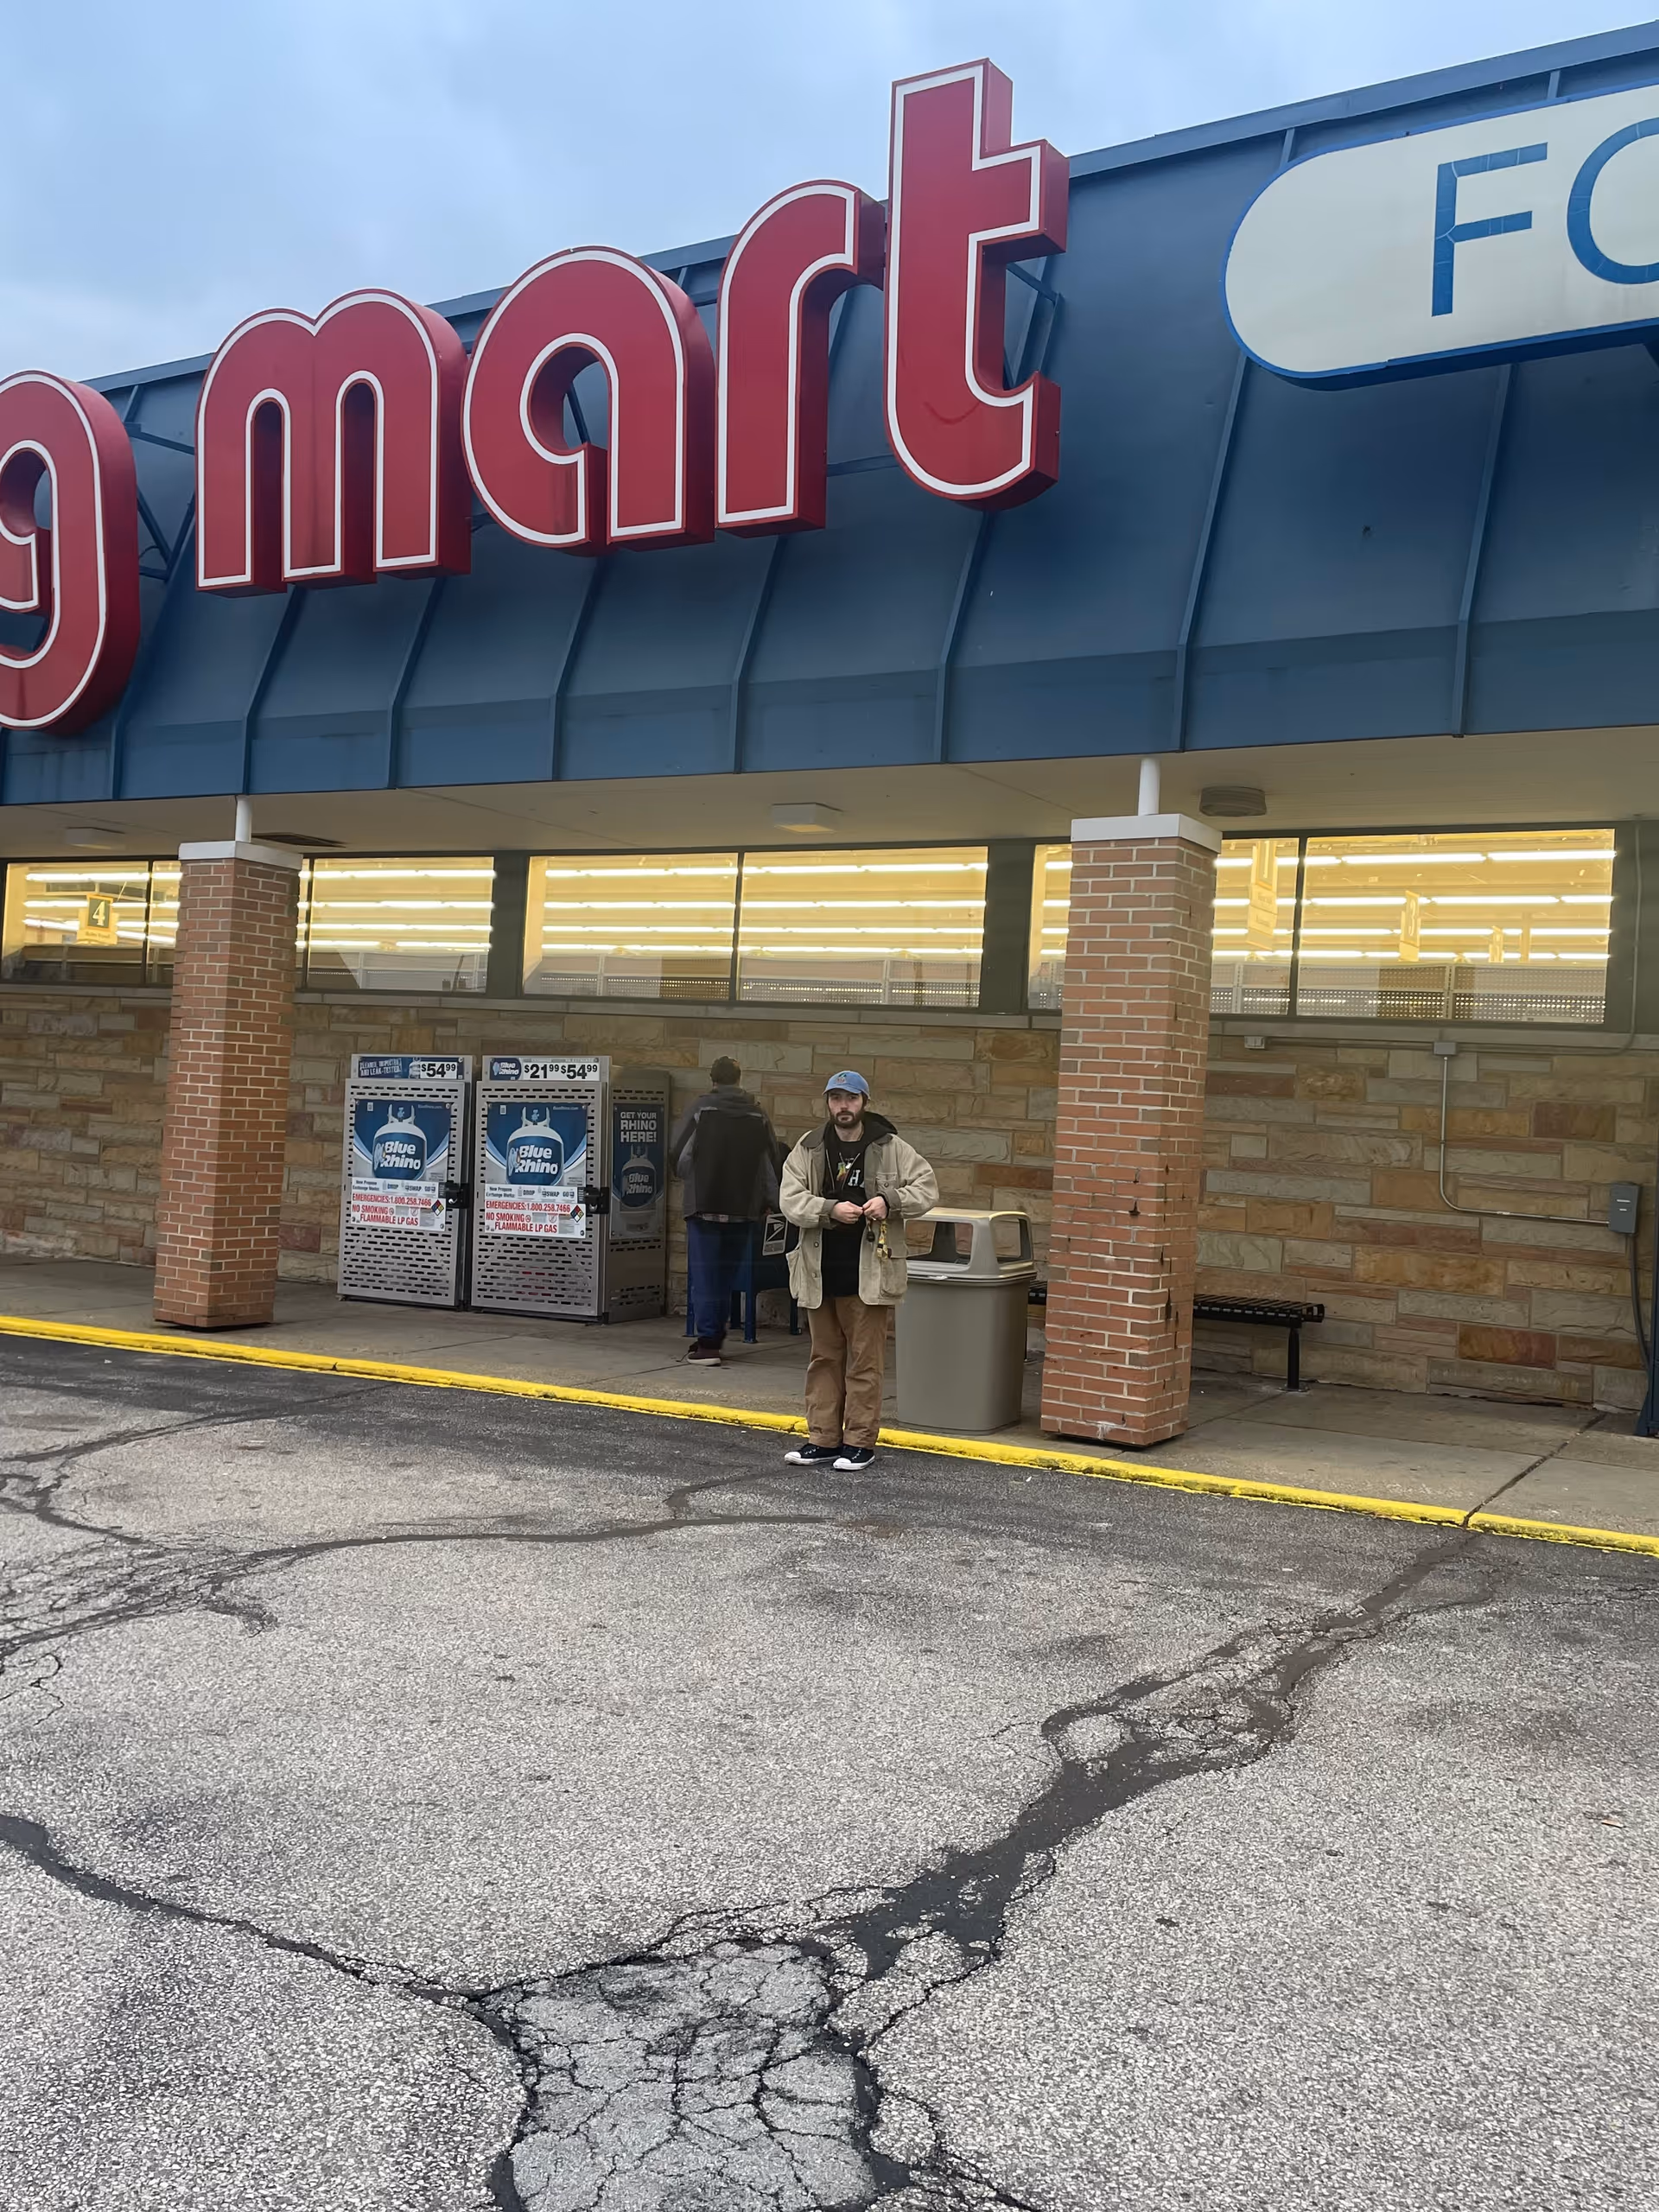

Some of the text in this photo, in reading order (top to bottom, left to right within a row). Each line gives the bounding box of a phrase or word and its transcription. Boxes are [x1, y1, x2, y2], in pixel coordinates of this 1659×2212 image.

[195, 58, 1068, 594] mart
[92, 900, 105, 926] 4
[620, 1120, 657, 1130] RHINO
[620, 1131, 657, 1142] HERE!
[385, 1141, 416, 1154] Blue
[519, 1145, 552, 1159] Blue
[380, 1154, 421, 1170] Rhino
[515, 1159, 558, 1175] Rhino
[628, 1173, 649, 1183] Blue
[626, 1183, 652, 1194] Rhino
[352, 1204, 360, 1213] NO
[361, 1205, 389, 1215] SMOKING
[359, 1213, 396, 1224] FLAMMABLE
[397, 1216, 404, 1225] LP
[406, 1217, 419, 1226] GAS
[486, 1211, 495, 1220] NO
[496, 1212, 525, 1223] SMOKING
[494, 1221, 557, 1234] FLAMMABLE LP GAS
